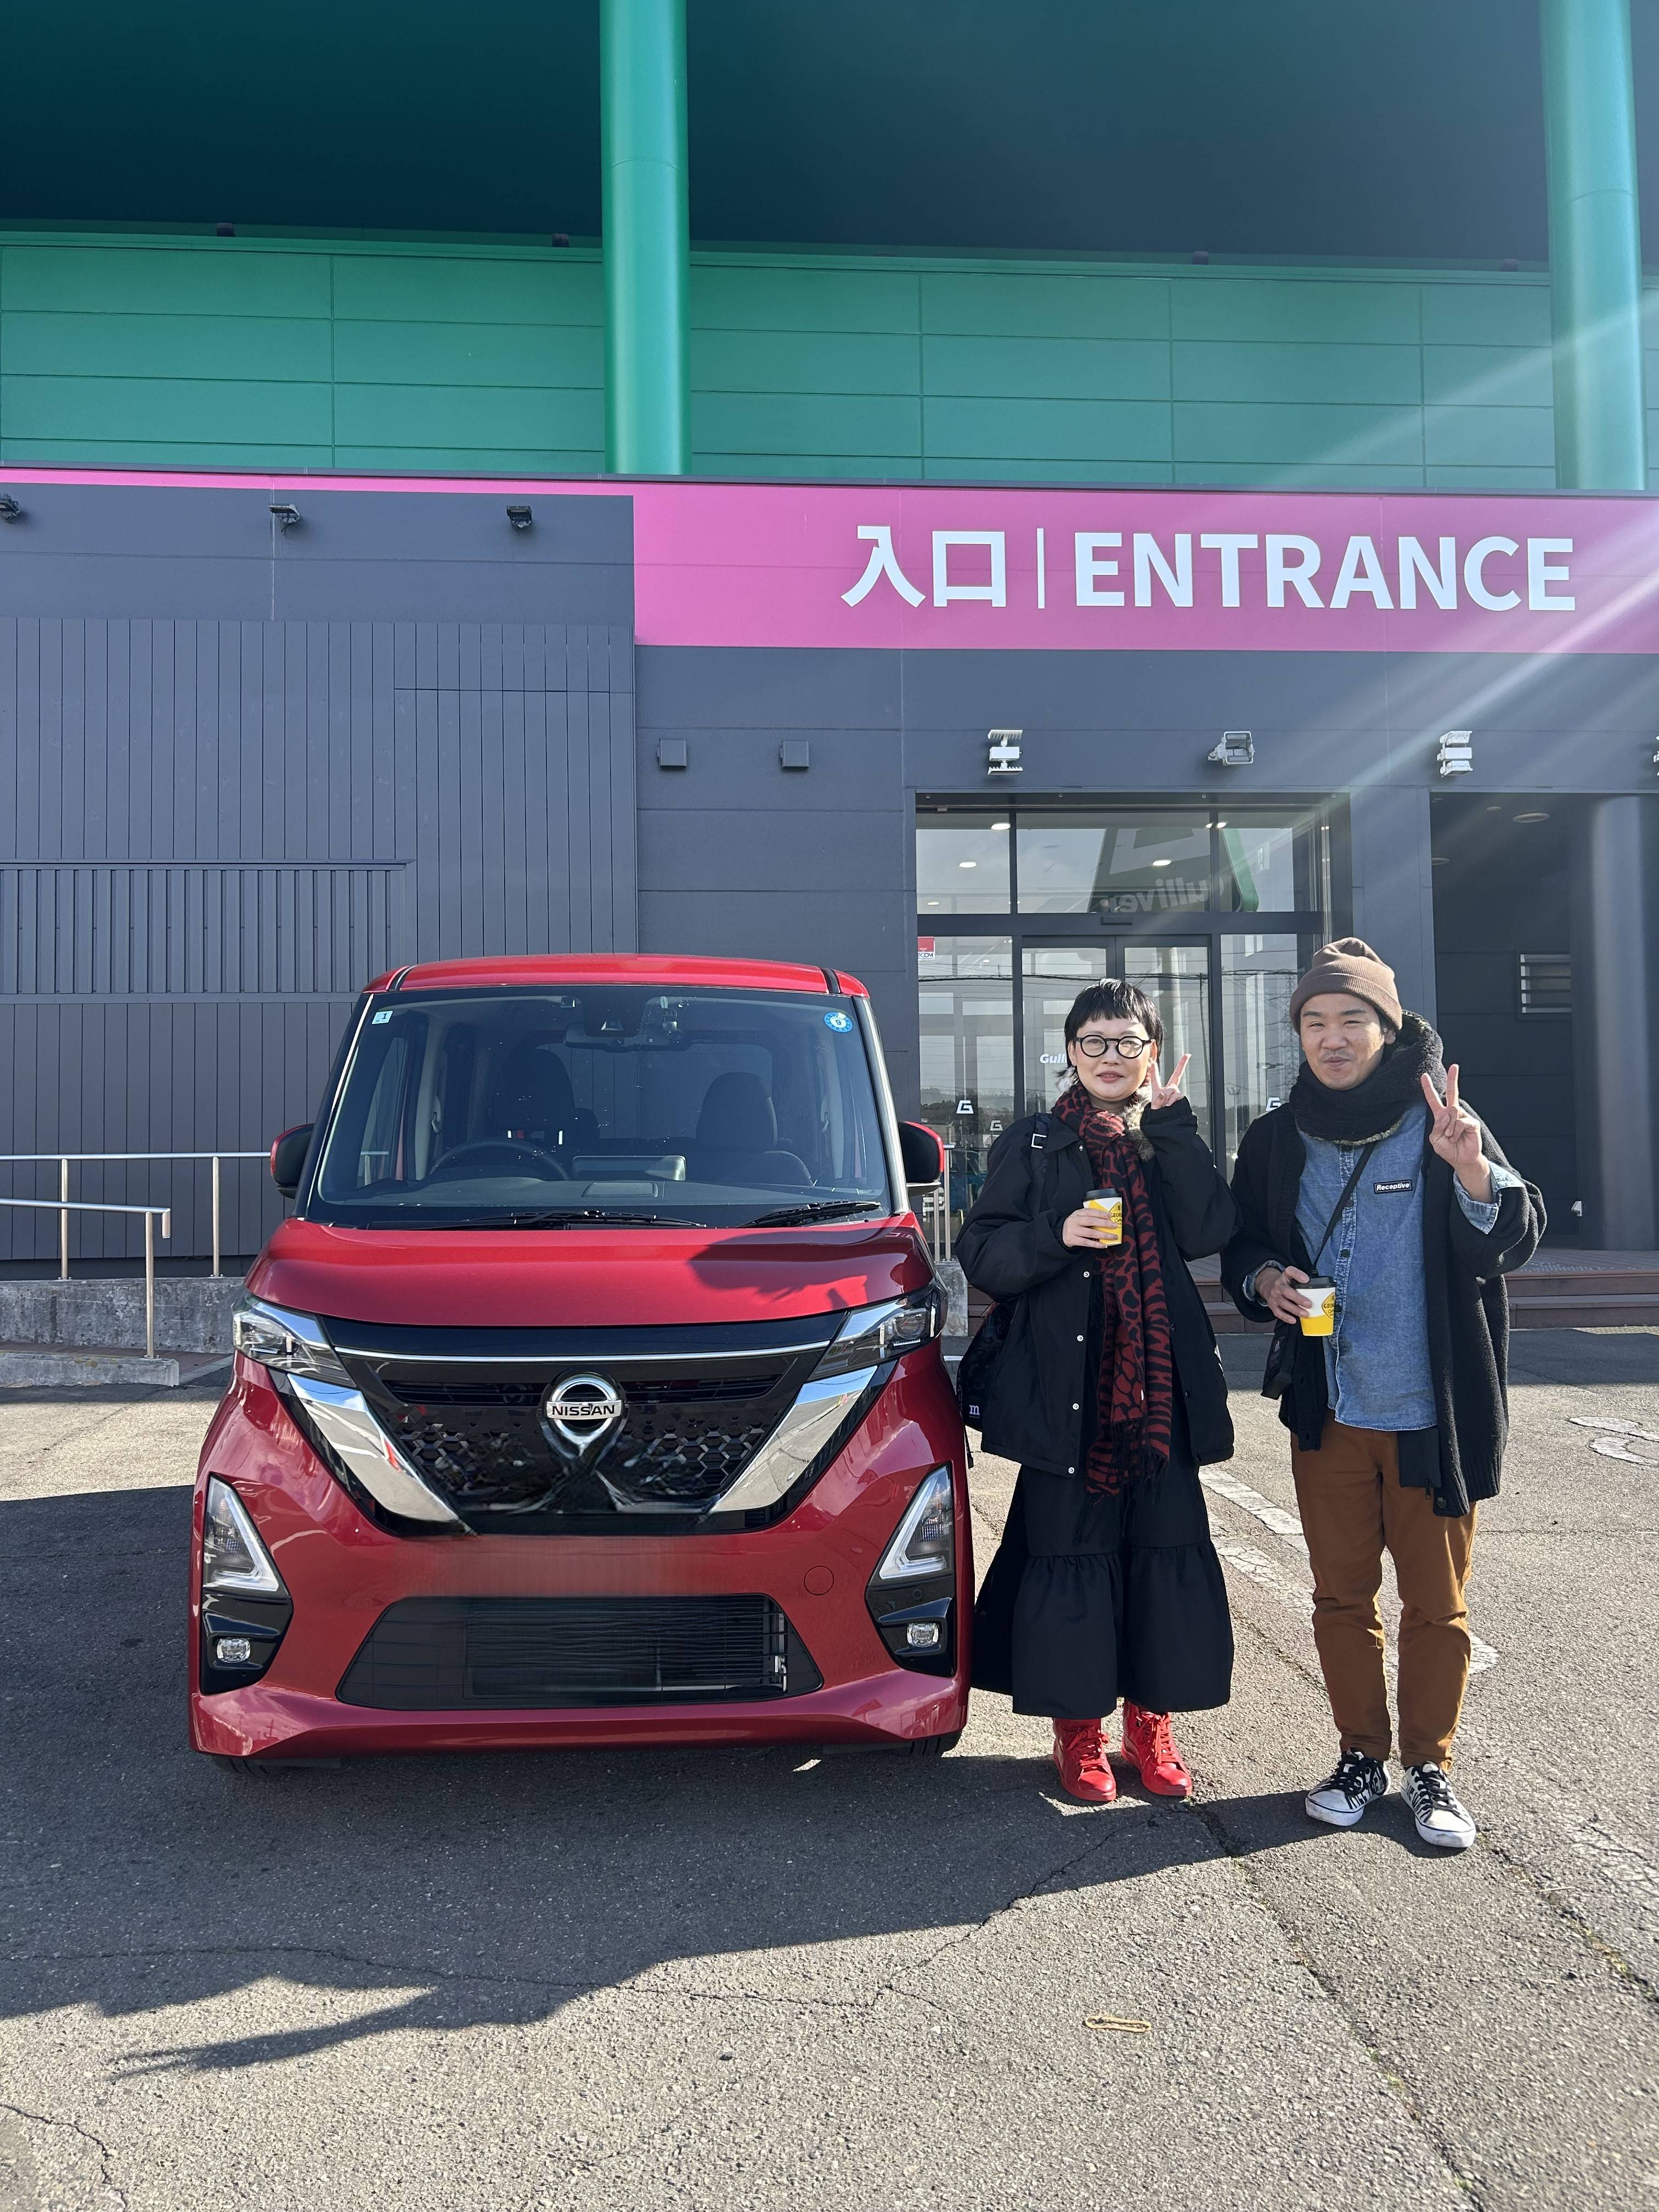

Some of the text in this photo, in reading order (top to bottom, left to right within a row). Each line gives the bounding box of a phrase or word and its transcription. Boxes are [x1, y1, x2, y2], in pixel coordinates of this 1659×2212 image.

[841, 525, 1006, 608] 入口
[1074, 532, 1576, 611] ENTRANCE
[1376, 1182, 1410, 1191] Receptive
[552, 1404, 615, 1416] NISSAN
